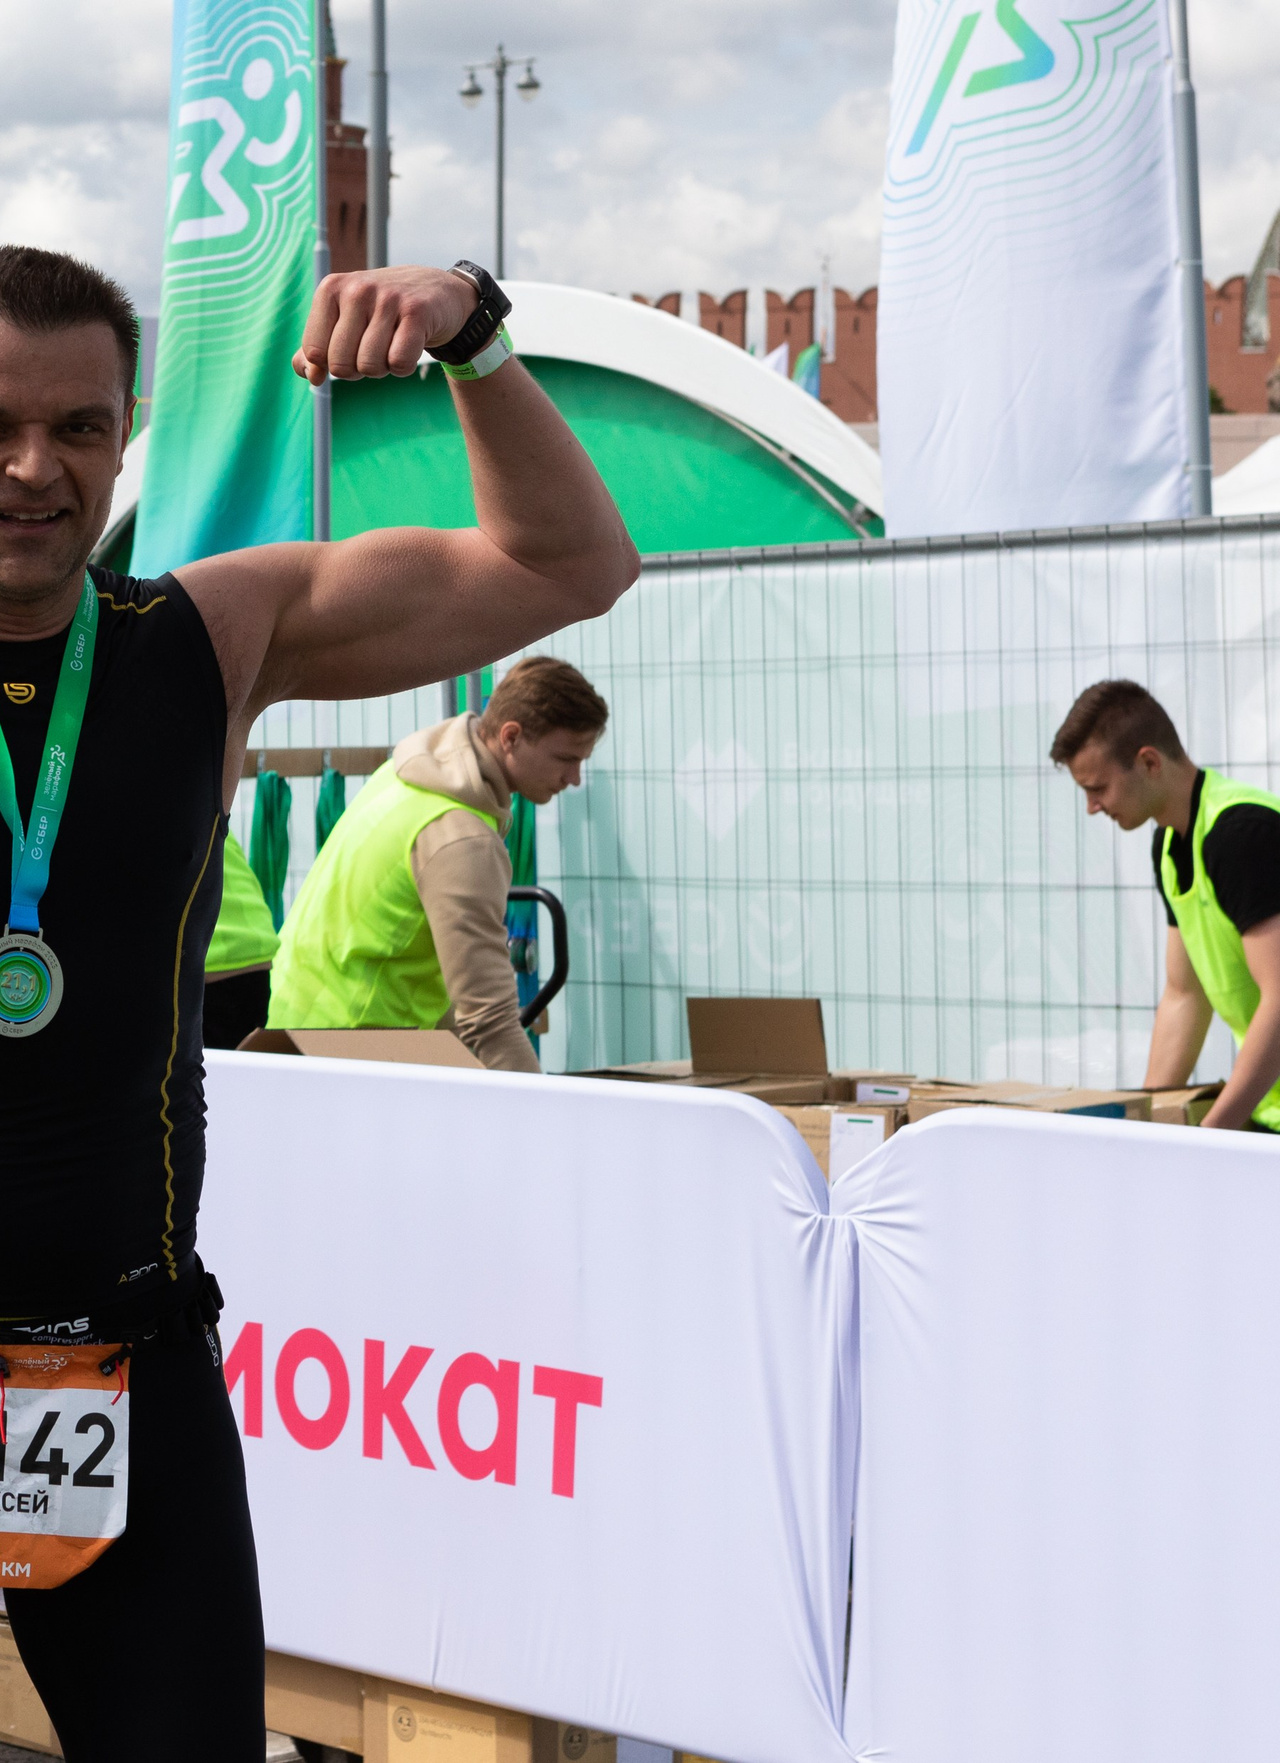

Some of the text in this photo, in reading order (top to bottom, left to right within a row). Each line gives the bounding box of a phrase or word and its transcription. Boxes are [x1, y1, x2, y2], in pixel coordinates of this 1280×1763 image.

[74, 633, 86, 659] СБЕР
[43, 761, 56, 796] зелёный
[50, 765, 63, 801] марафон
[35, 815, 49, 845] СБЕР
[1, 971, 39, 994] 21,1
